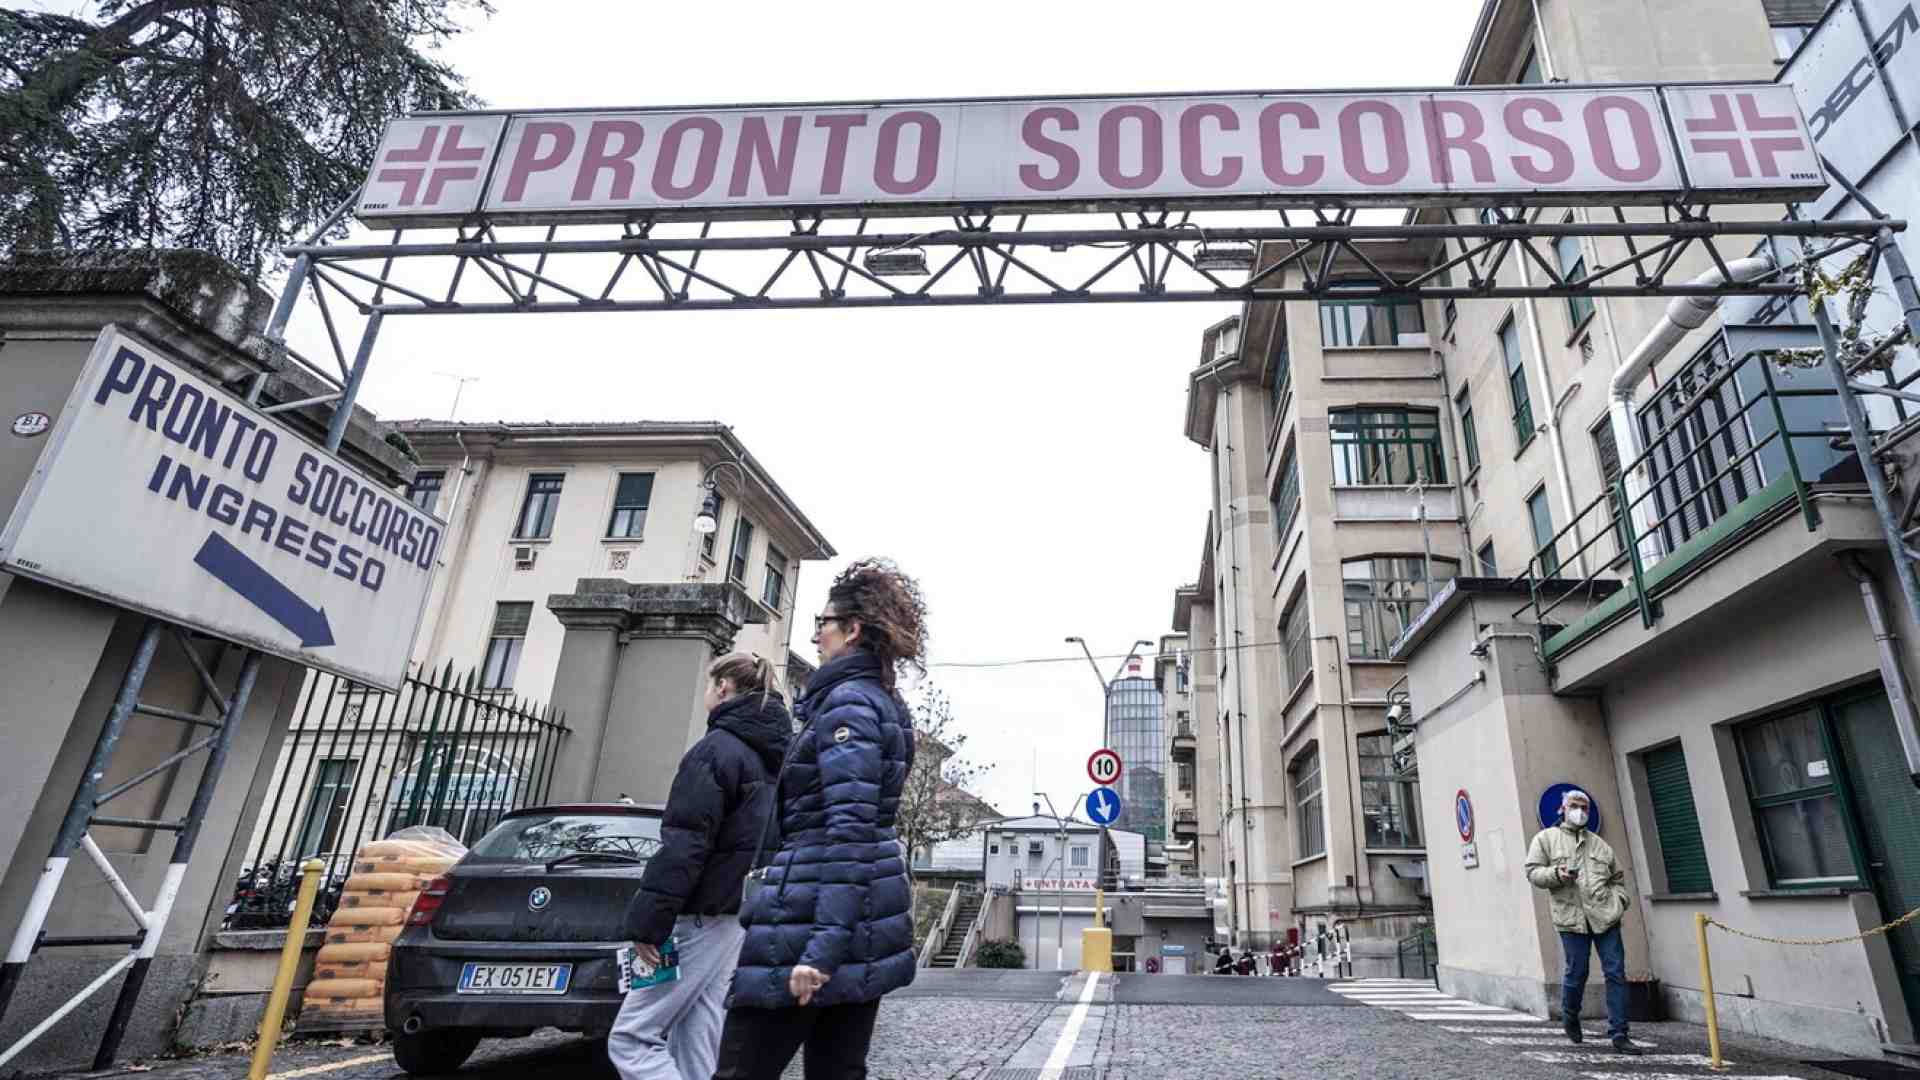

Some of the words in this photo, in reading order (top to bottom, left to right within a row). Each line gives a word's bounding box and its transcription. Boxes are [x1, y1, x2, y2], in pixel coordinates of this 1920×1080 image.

[502, 110, 942, 202] PRONTO
[1018, 95, 1662, 192] SOCCORSO
[94, 345, 278, 484] PRONTO
[287, 452, 440, 571] SOCCORSO
[148, 454, 386, 592] INGRESSO
[1096, 758, 1113, 776] 10
[471, 967, 497, 987] EX
[501, 967, 558, 987] 051EY
